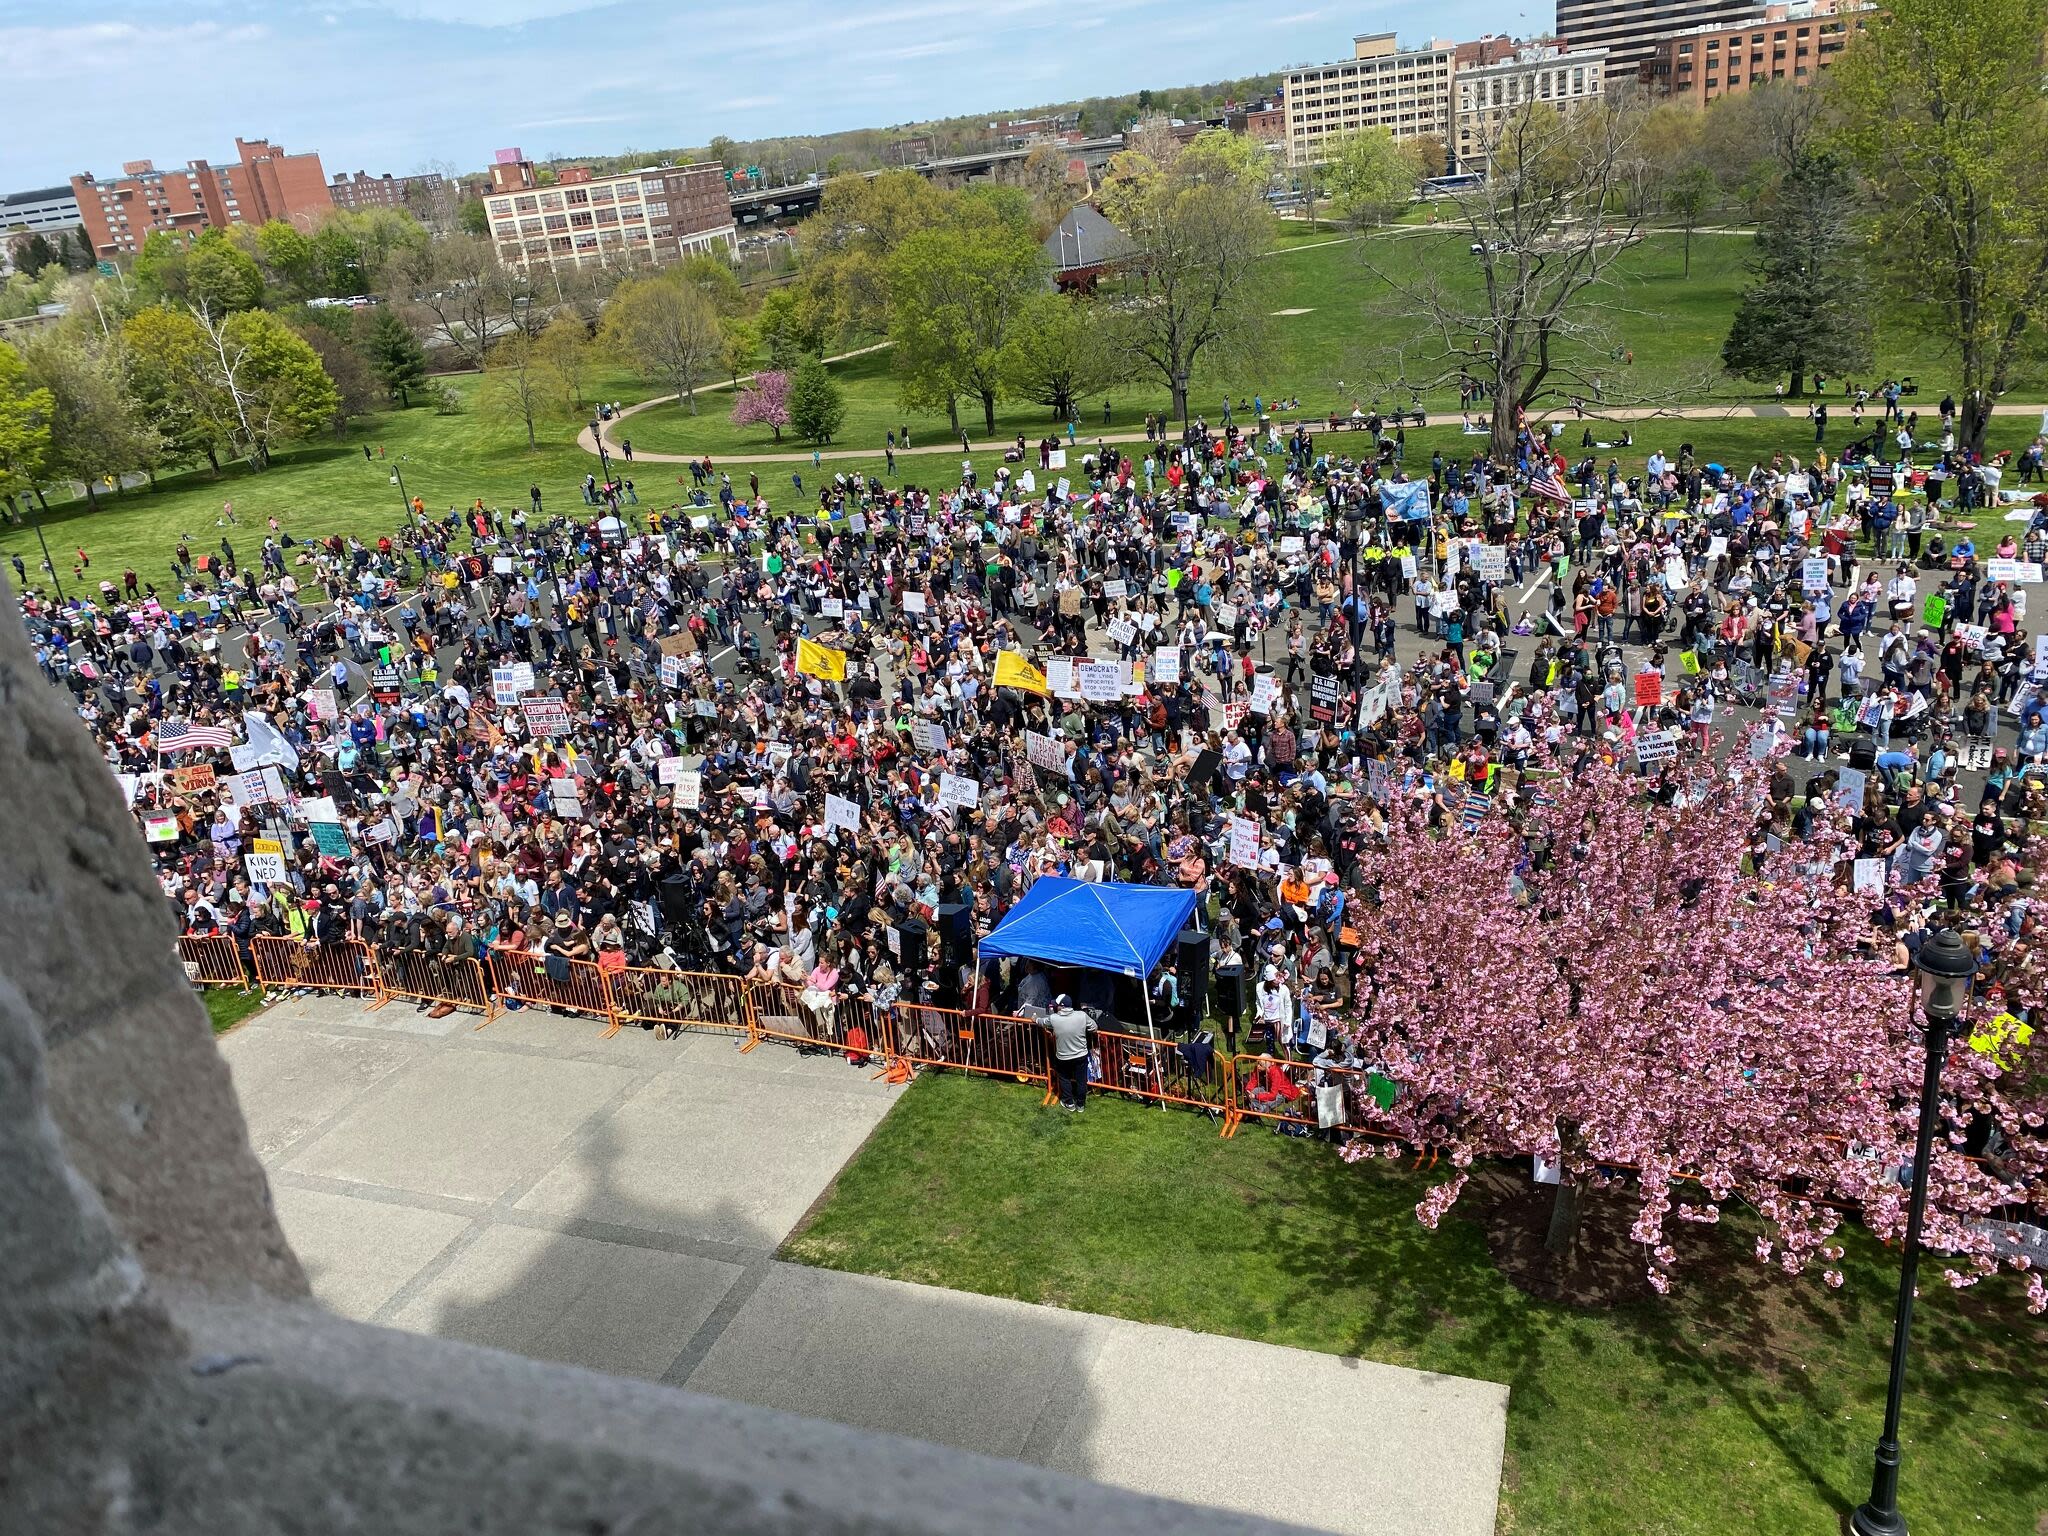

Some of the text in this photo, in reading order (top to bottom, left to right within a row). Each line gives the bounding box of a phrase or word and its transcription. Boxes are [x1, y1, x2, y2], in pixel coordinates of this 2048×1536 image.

[1080, 664, 1120, 674] DEMOCRATS
[494, 671, 513, 681] OUR KIDS
[1324, 679, 1336, 689] LAW
[1312, 690, 1337, 703] VACCINES
[527, 704, 562, 714] EXEMPTION
[1319, 700, 1328, 708] AS
[531, 725, 553, 735] DEATH
[1648, 741, 1674, 750] VACCINE
[1841, 771, 1863, 788] GOD
[181, 778, 216, 792] VIRUS
[678, 783, 696, 793] RISK
[948, 780, 971, 792] POLAND
[675, 797, 696, 806] CHOICE
[941, 791, 975, 806] UNITED STATES
[249, 856, 277, 866] KING
[255, 868, 277, 880] NED
[1852, 1146, 1871, 1158] WE
